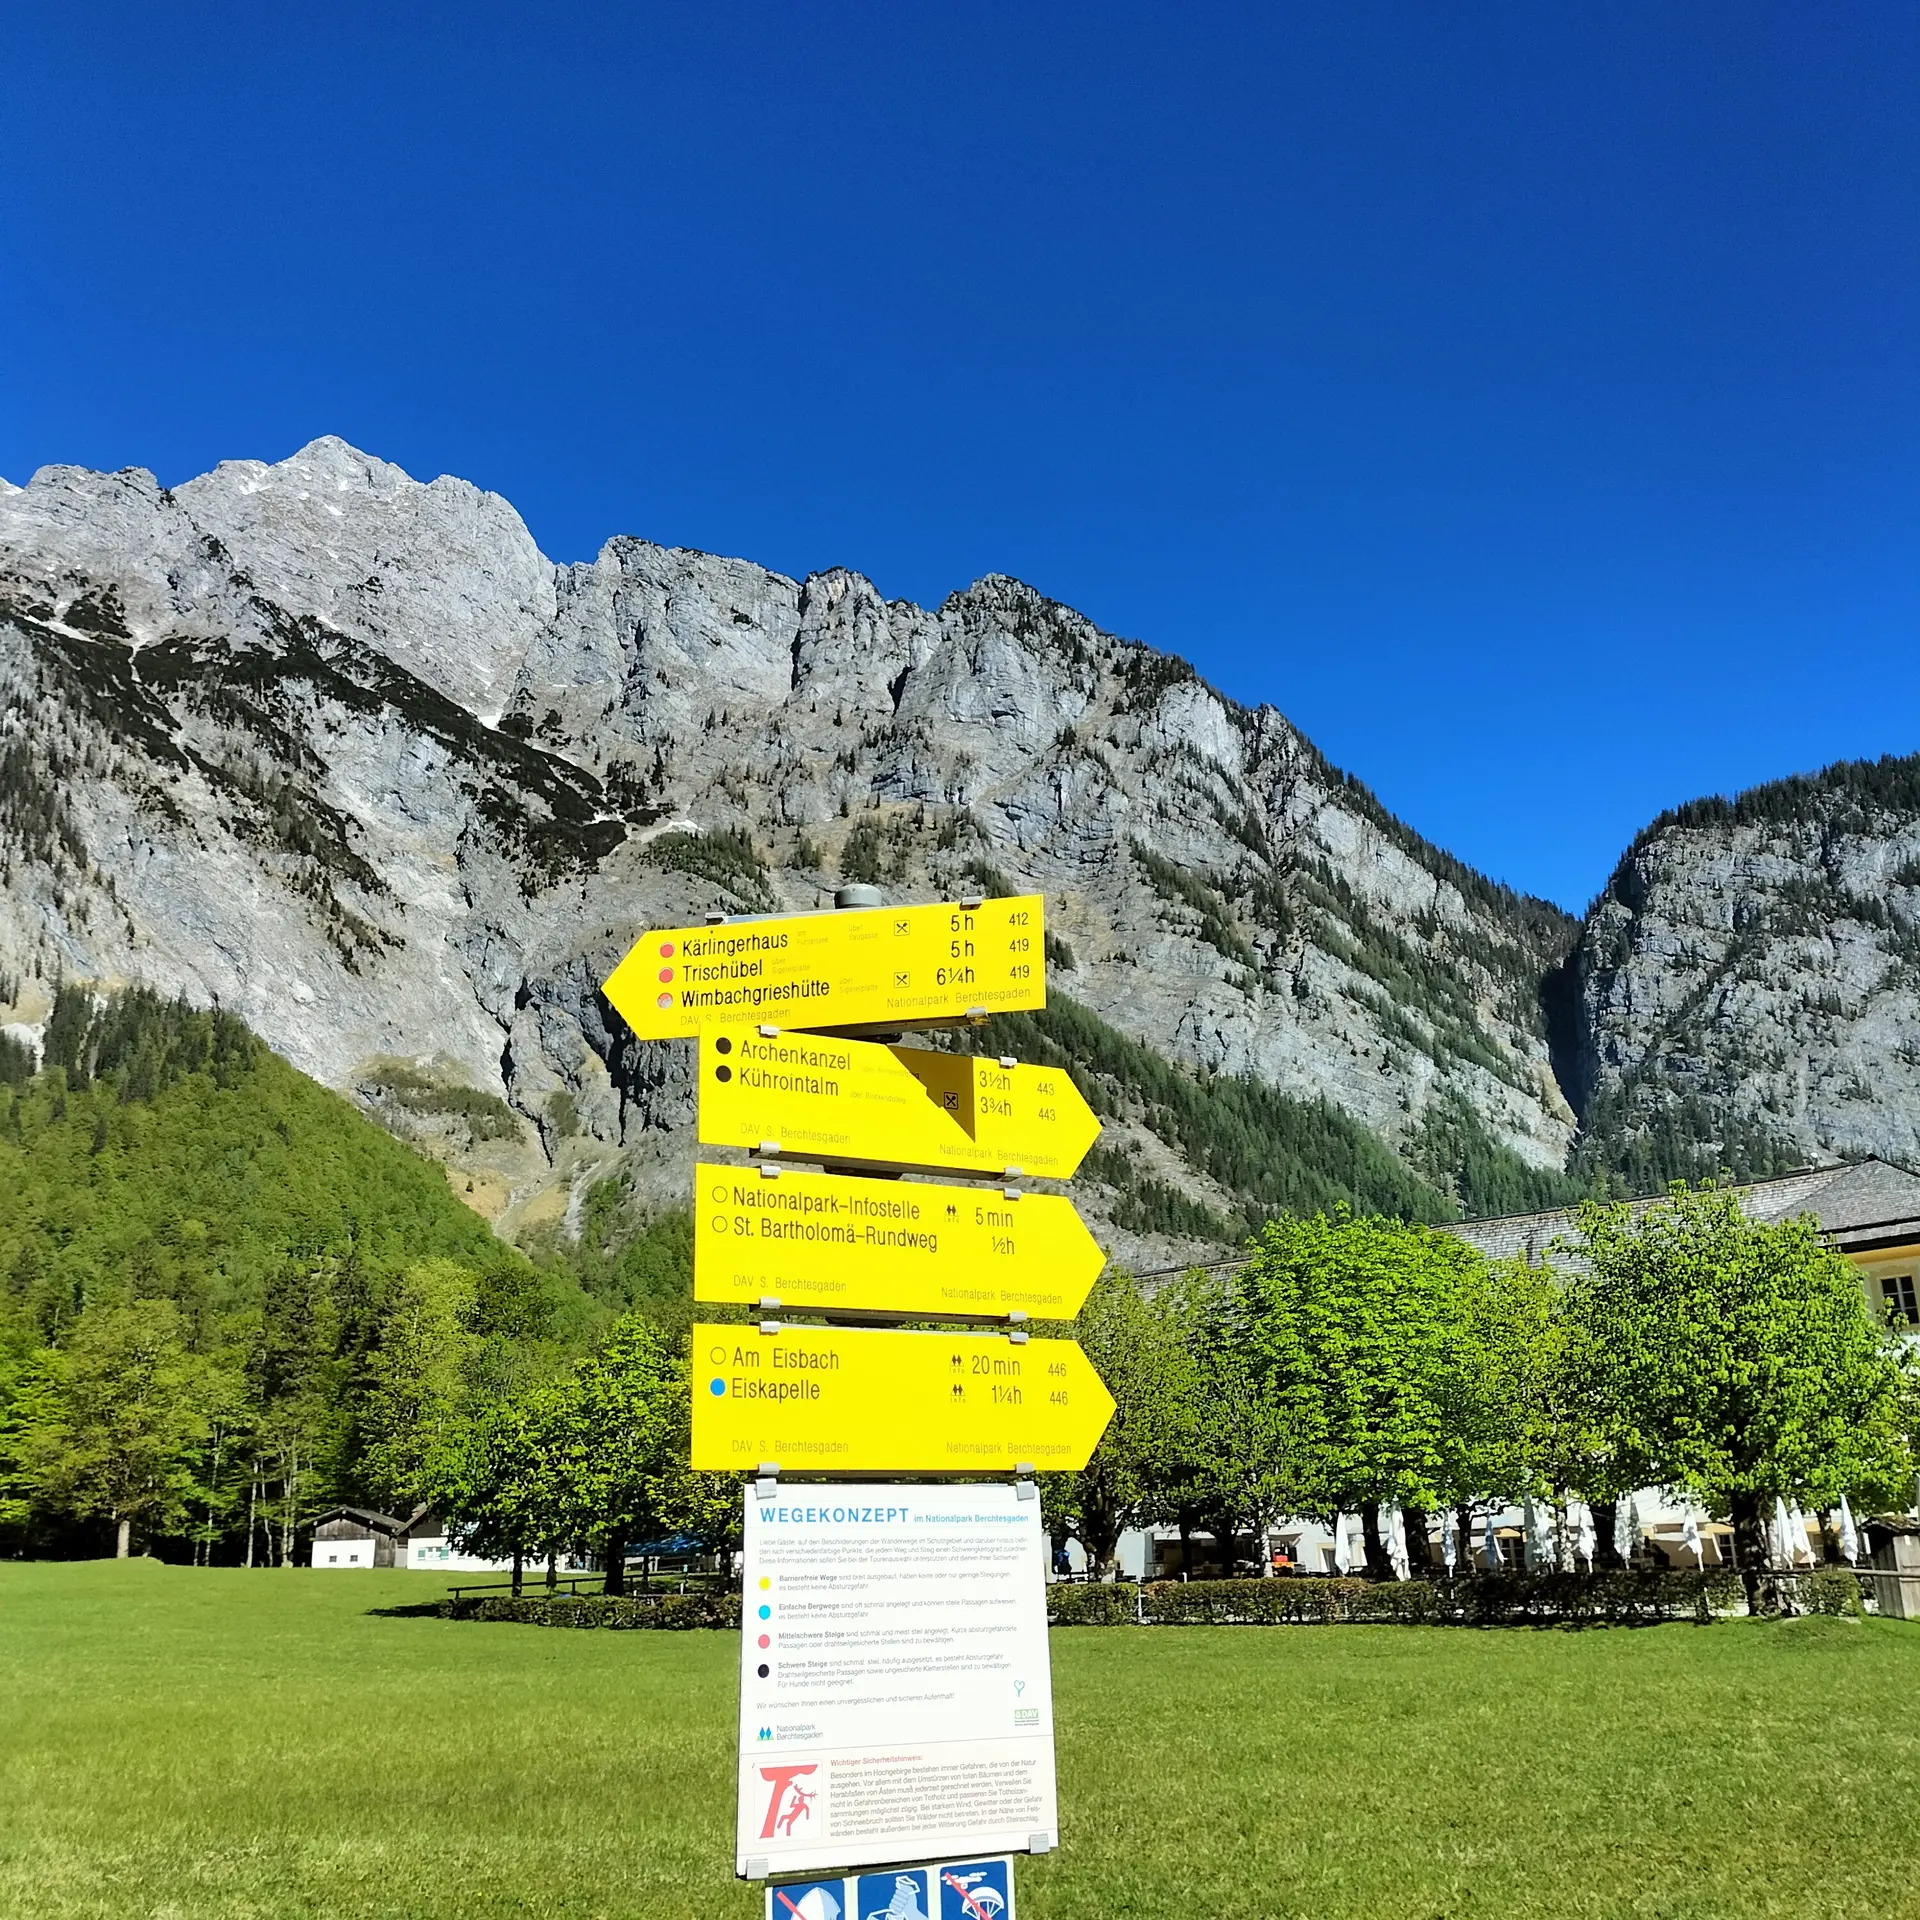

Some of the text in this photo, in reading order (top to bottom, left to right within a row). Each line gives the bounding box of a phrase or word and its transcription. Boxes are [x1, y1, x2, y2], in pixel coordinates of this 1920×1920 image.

[682, 912, 1029, 957] Kärlingerhaus 5 h 412
[682, 938, 1029, 982] Trischübel 5 h 419
[681, 979, 830, 1008] Wimbachgrieshütte
[1010, 964, 1030, 979] 419
[680, 1015, 699, 1026] DAV
[720, 1008, 790, 1023] Berchtesgaden
[887, 994, 949, 1009] Nationalpark
[956, 987, 1030, 1004] Berchtesgaden
[740, 1040, 851, 1071] Archenkanzel
[1037, 1082, 1055, 1096] 443
[740, 1067, 839, 1096] Kührointalm
[1038, 1108, 1056, 1122] 443
[740, 1123, 1059, 1166] DAV S. Berchtesgaden Nationalpark Berchtesgaden
[733, 1216, 754, 1237] St.
[975, 1207, 984, 1226] 5
[987, 1209, 1014, 1228] min
[733, 1275, 1063, 1305] DAV S. Berchtesgaden Nationalpark Berchtesgaden
[732, 1346, 1067, 1377] Am Eisbach 20 min 446
[732, 1378, 821, 1404] Eiskapelle
[1050, 1390, 1068, 1405] 446
[732, 1439, 1072, 1456] DAV S. Berchtesgaden Nationalpark Berchtesgaden
[759, 1507, 1029, 1524] WEGEKONZEPT im Nationalpark Berchtesgaden
[776, 1724, 815, 1733] Nationalpark
[776, 1732, 823, 1741] Berchtesgaden
[830, 1754, 923, 1767] Wichtiger Sicherheitshinweis:
[830, 1771, 863, 1779] Besonders
[873, 1768, 911, 1777] Hochgebirge
